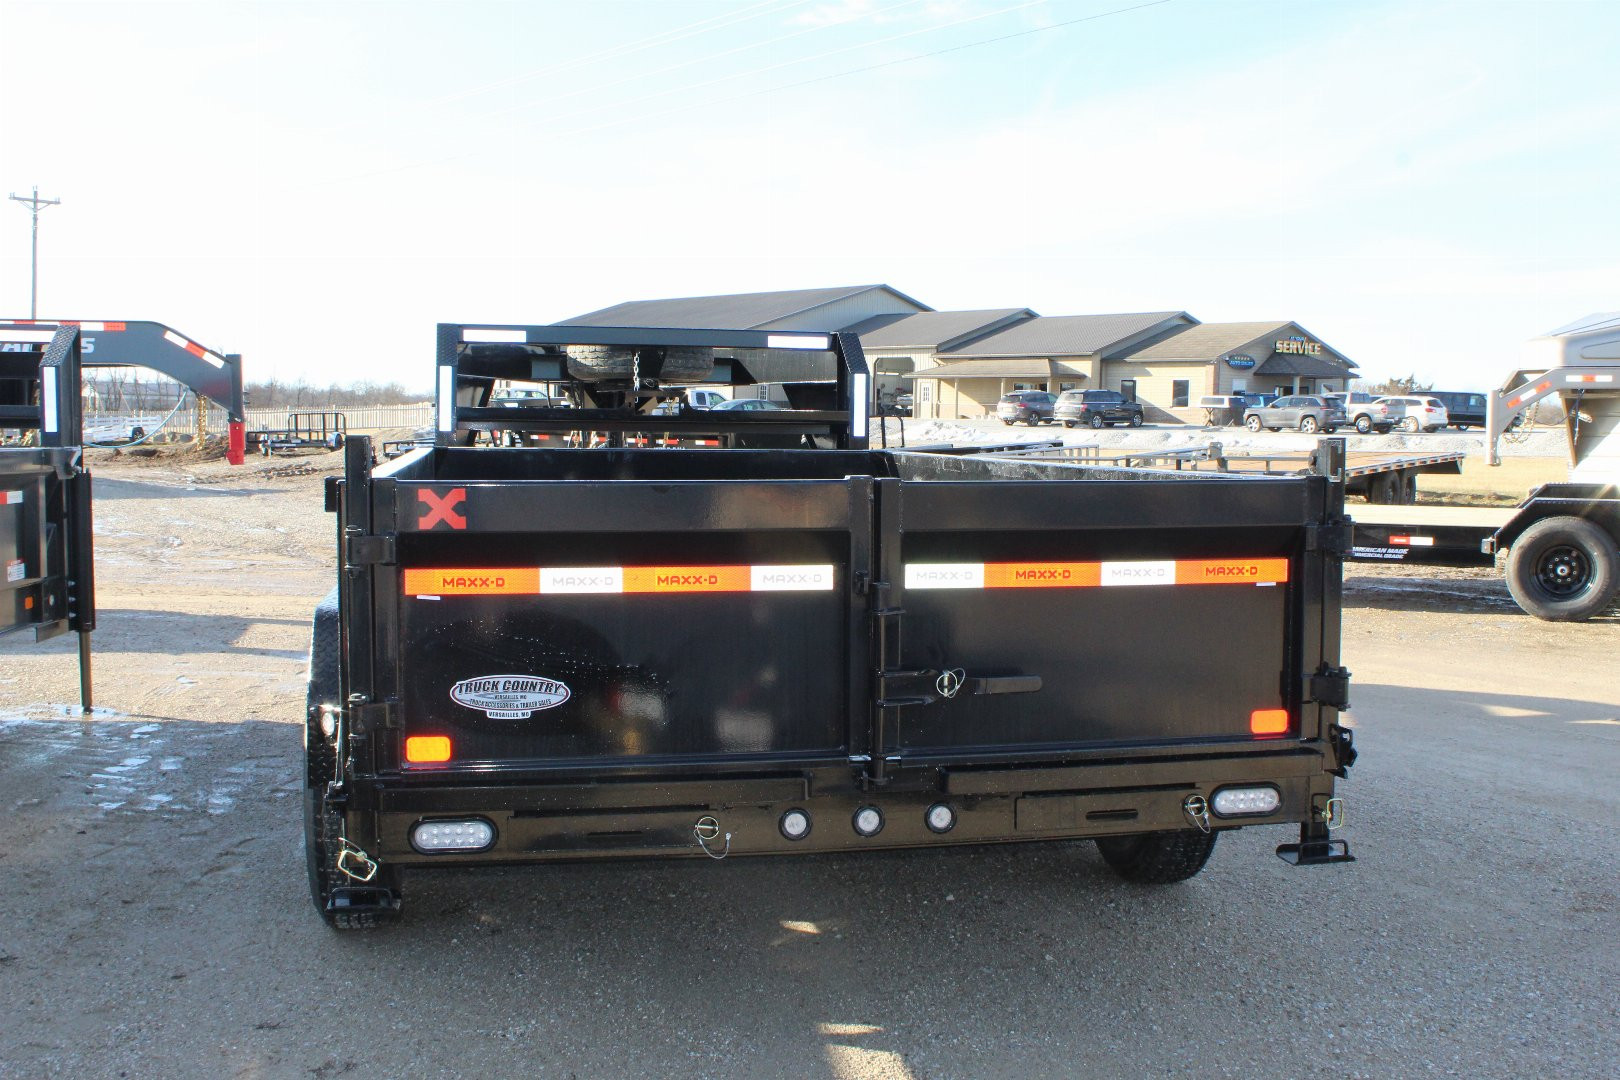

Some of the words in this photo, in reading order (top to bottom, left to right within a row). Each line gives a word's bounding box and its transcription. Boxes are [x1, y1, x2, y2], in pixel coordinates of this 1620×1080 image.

[1275, 338, 1321, 355] SERVICE
[457, 680, 500, 694] TRUCK
[502, 680, 562, 694] COUNTRY
[520, 701, 538, 709] TRAILER
[537, 698, 552, 707] SALES
